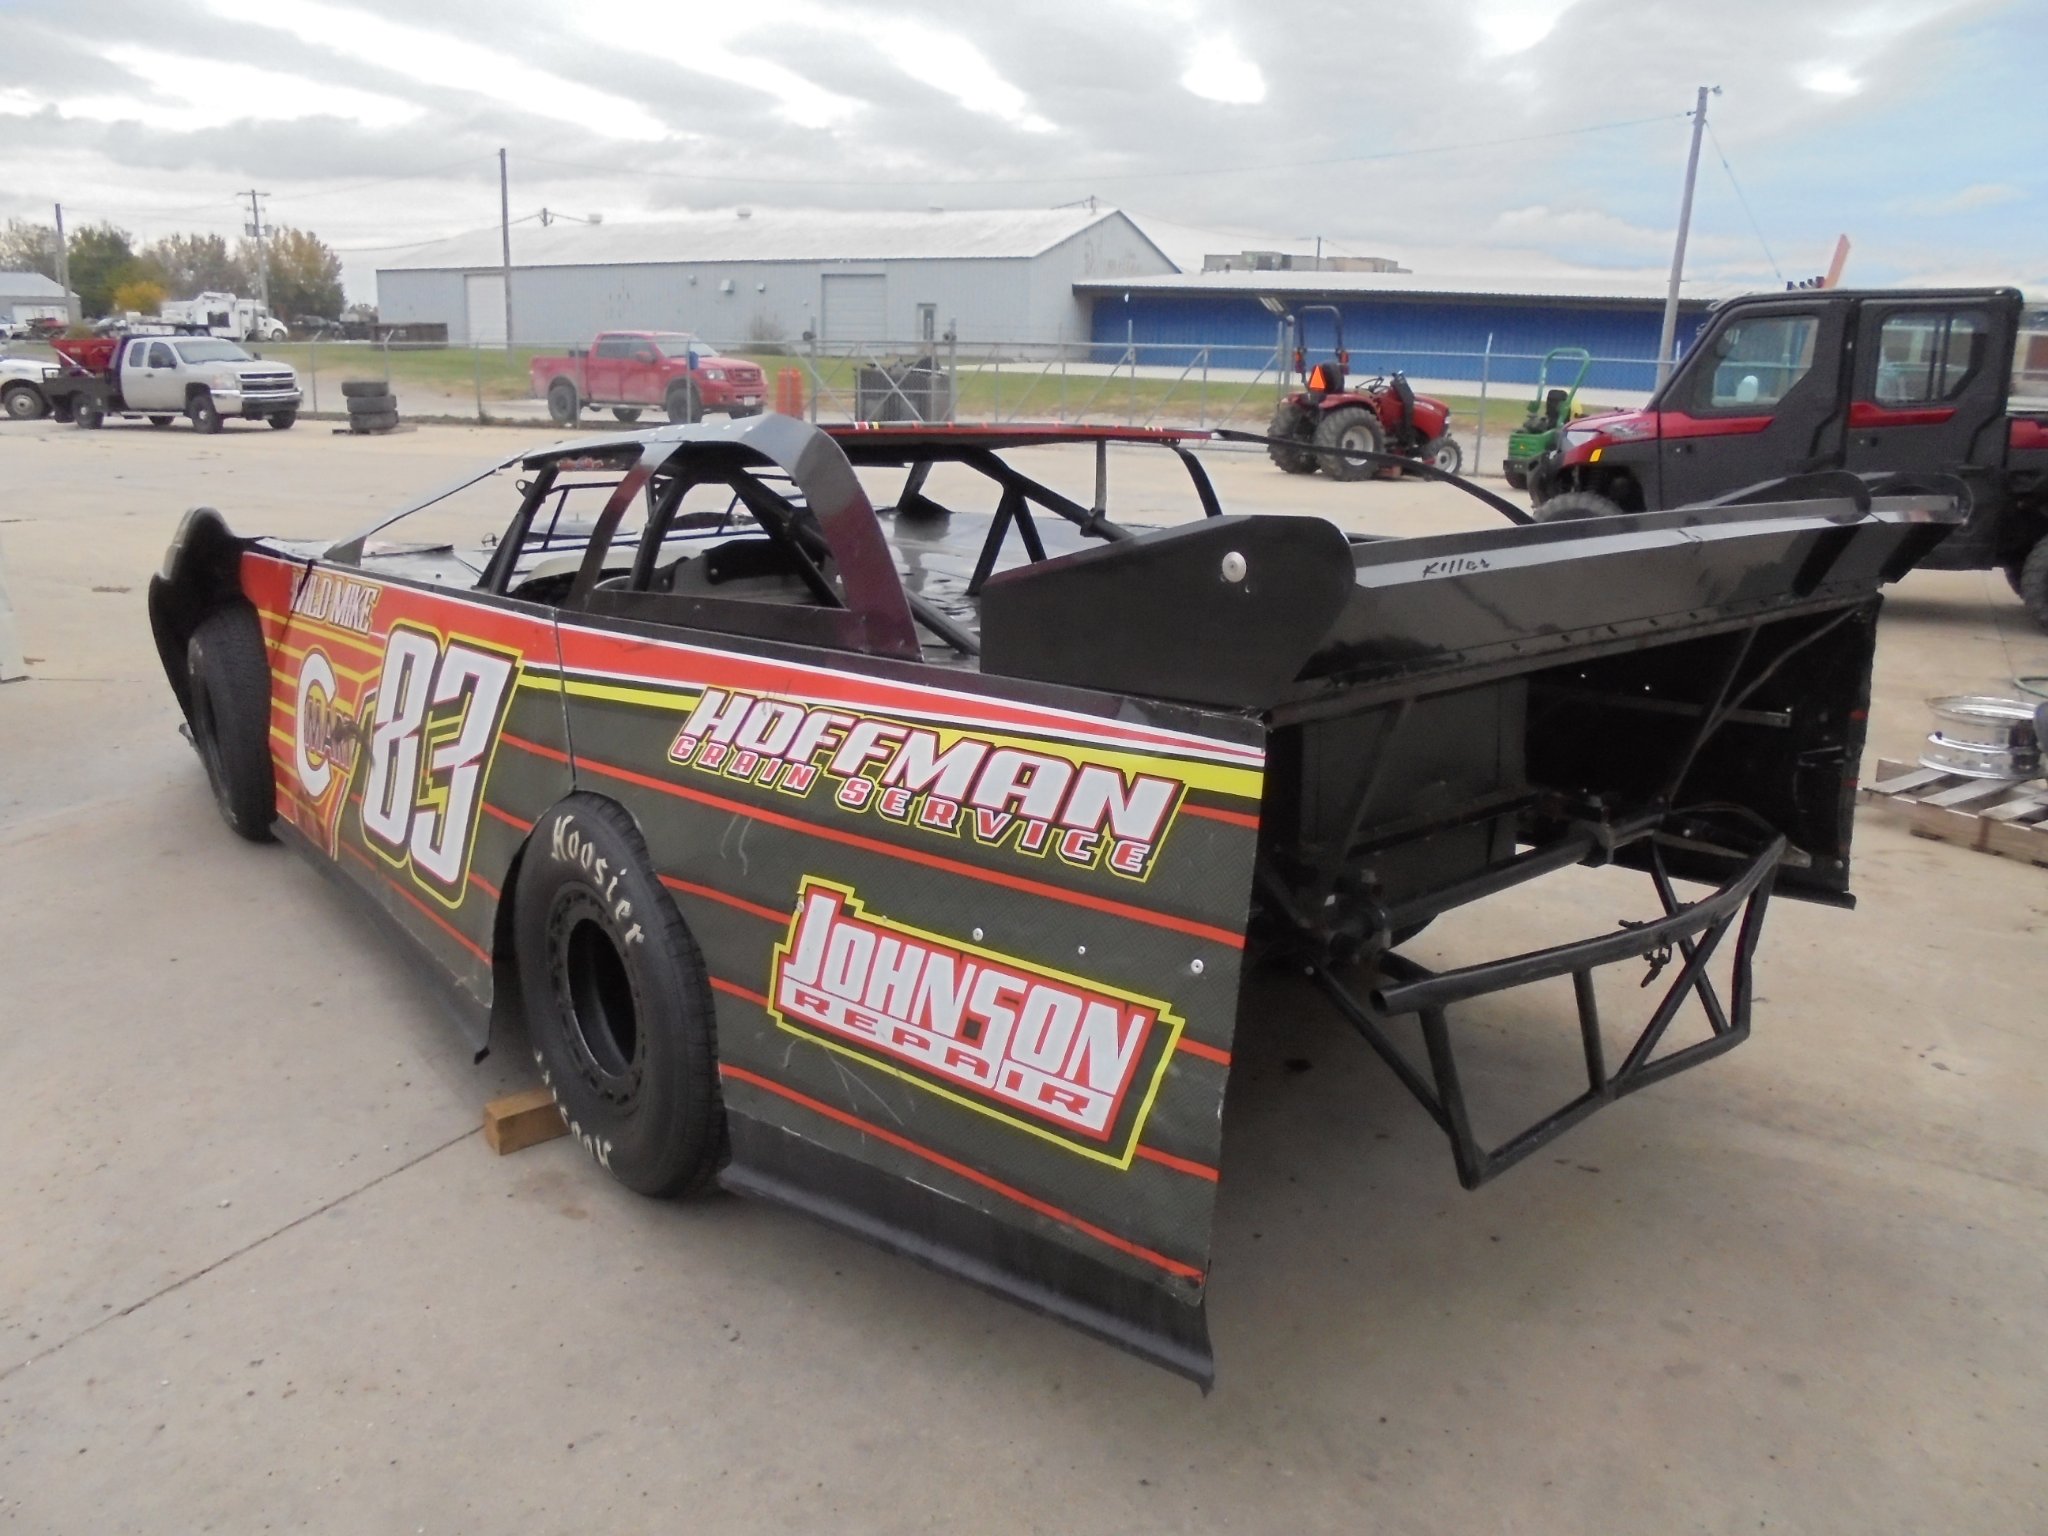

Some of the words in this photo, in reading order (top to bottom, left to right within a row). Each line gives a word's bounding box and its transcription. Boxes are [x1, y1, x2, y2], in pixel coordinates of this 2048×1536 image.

[289, 572, 332, 620] WILD
[329, 580, 379, 635] MIKE
[362, 629, 514, 884] 83
[669, 734, 822, 793] GRAIN
[837, 777, 1152, 874] SERVICE
[680, 686, 1184, 843] HOFFMAN
[551, 815, 645, 946] Hoosier
[783, 893, 1146, 1096] JOHNSON
[794, 988, 1090, 1118] REPAIR
